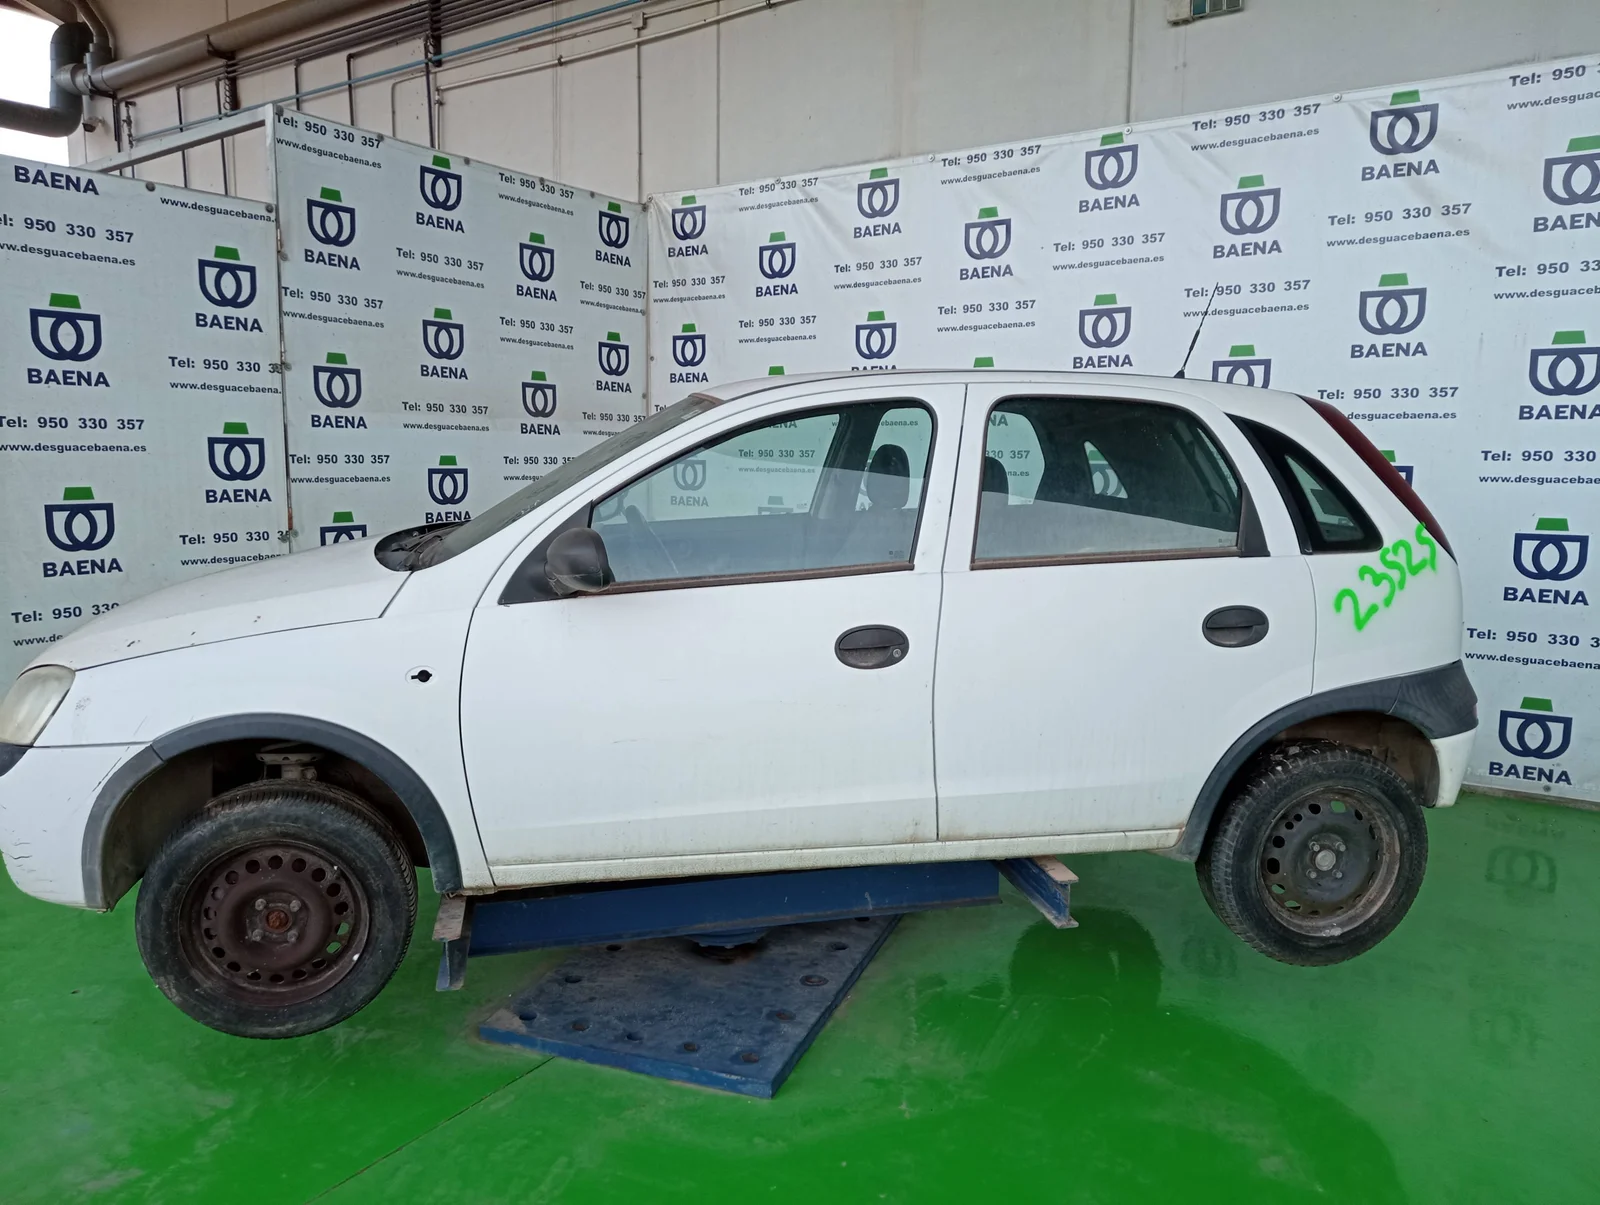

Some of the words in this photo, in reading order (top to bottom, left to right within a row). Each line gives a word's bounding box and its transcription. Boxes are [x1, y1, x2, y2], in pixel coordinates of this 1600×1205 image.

[1509, 72, 1541, 86] Tel:
[1552, 65, 1586, 80] 950
[1192, 119, 1216, 131] Tel:
[1224, 114, 1250, 126] 950
[1259, 108, 1285, 122] 330
[1294, 103, 1321, 116] 357
[275, 112, 298, 128] Tel:
[304, 121, 327, 136] 950
[334, 129, 354, 142] 330
[361, 135, 381, 149] 357
[1191, 128, 1319, 151] www.desguacebaena.es
[276, 137, 382, 169] www.desguacebaena.es
[941, 157, 960, 167] Tel:
[967, 152, 987, 164] 950
[994, 149, 1014, 160] 330
[1020, 144, 1041, 156] 357
[940, 167, 1040, 185] www.desguacebaena.es
[1362, 159, 1440, 181] BAENA
[14, 165, 99, 195] BAENA
[498, 172, 515, 184] Tel:
[520, 178, 536, 190] 950
[540, 182, 556, 195] 330
[560, 188, 574, 199] 357
[738, 186, 754, 196] Tel:
[759, 183, 776, 194] 950
[780, 180, 797, 190] 330
[802, 177, 818, 188] 357
[1079, 194, 1140, 213] BAENA
[416, 212, 465, 233] BAENA
[1328, 214, 1355, 226] Tel:
[1365, 210, 1393, 223] 950
[1402, 206, 1431, 219] 330
[1441, 203, 1472, 216] 357
[24, 218, 56, 232] 950
[66, 224, 96, 238] 330
[106, 229, 134, 243] 357
[854, 222, 902, 238] BAENA
[1326, 230, 1470, 247] www.desguacebaena.es
[1053, 242, 1075, 252] Tel:
[1082, 238, 1104, 250] 950
[1112, 235, 1134, 246] 330
[1142, 232, 1165, 244] 357
[1213, 240, 1282, 259] BAENA
[304, 248, 360, 270] BAENA
[396, 247, 415, 259] Tel:
[420, 252, 438, 264] 950
[444, 256, 462, 268] 330
[467, 260, 484, 271] 357
[596, 250, 631, 267] BAENA
[668, 244, 708, 258] BAENA
[834, 264, 851, 273] Tel:
[856, 262, 874, 271] 950
[880, 259, 898, 269] 330
[904, 256, 922, 266] 357
[1052, 256, 1164, 270] www.desguacebaena.es
[1495, 265, 1526, 277] Tel:
[1537, 262, 1569, 275] 950
[396, 270, 484, 288] www.desguacebaena.es
[960, 264, 1013, 280] BAENA
[580, 280, 594, 290] Tel:
[598, 284, 612, 294] 950
[616, 287, 629, 296] 330
[632, 289, 646, 300] 357
[653, 280, 668, 288] Tel:
[672, 278, 686, 287] 950
[691, 277, 706, 286] 330
[710, 276, 725, 284] 357
[756, 283, 798, 297] BAENA
[834, 277, 922, 290] www.desguacebaena.es
[1184, 287, 1209, 298] Tel:
[1216, 284, 1242, 296] 950
[1250, 282, 1275, 294] 330
[1284, 280, 1310, 291] 357
[281, 286, 304, 299] Tel:
[310, 290, 331, 302] 950
[338, 294, 358, 306] 330
[364, 298, 383, 309] 357
[516, 284, 557, 302] BAENA
[938, 306, 956, 315] Tel:
[963, 304, 982, 314] 950
[989, 302, 1009, 312] 330
[1015, 300, 1036, 310] 357
[196, 312, 263, 332] BAENA
[282, 310, 385, 328] www.desguacebaena.es
[500, 316, 516, 326] Tel:
[520, 319, 535, 329] 950
[540, 322, 555, 332] 330
[558, 324, 573, 334] 357
[738, 320, 754, 328] Tel:
[758, 318, 774, 327] 950
[779, 316, 795, 326] 330
[800, 315, 816, 324] 357
[937, 321, 1035, 332] www.desguacebaena.es
[1350, 342, 1428, 358] BAENA
[168, 356, 195, 368] Tel:
[203, 359, 228, 370] 950
[236, 361, 260, 372] 330
[1073, 354, 1133, 369] BAENA
[27, 368, 110, 387] BAENA
[420, 364, 468, 380] BAENA
[670, 372, 708, 383] BAENA
[596, 380, 632, 393] BAENA
[1318, 389, 1344, 400] Tel:
[1354, 388, 1381, 399] 950
[1391, 388, 1419, 398] 330
[1429, 387, 1458, 398] 357
[402, 402, 420, 411] Tel:
[426, 403, 444, 412] 950
[450, 404, 467, 414] 330
[472, 406, 488, 414] 357
[38, 416, 68, 428] 950
[78, 418, 107, 429] 330
[117, 419, 144, 430] 357
[311, 414, 367, 429] BAENA
[403, 422, 490, 431] www.desguacebaena.es
[520, 423, 560, 435] BAENA
[0, 443, 146, 454] www.desguacebaena.es
[738, 449, 754, 457] Tel:
[758, 449, 774, 458] 950
[778, 450, 794, 458] 330
[799, 450, 815, 458] 357
[1009, 450, 1030, 459] 357
[1481, 450, 1511, 461] Tel:
[1522, 450, 1553, 461] 950
[1564, 450, 1596, 462] 330
[289, 454, 311, 464] Tel:
[317, 454, 338, 464] 950
[344, 454, 364, 464] 330
[371, 454, 390, 464] 357
[503, 456, 519, 464] Tel:
[524, 456, 539, 464] 950
[543, 456, 558, 464] 330
[290, 475, 391, 484] www.desguacebaena.es
[206, 488, 272, 503] BAENA
[670, 496, 709, 507] BAENA
[425, 510, 472, 524] BAENA
[179, 534, 205, 545] Tel:
[213, 532, 238, 543] 950
[246, 531, 269, 542] 330
[43, 558, 123, 578] BAENA
[1503, 587, 1589, 606] BAENA
[11, 610, 42, 623] Tel:
[52, 606, 82, 619] 950
[1467, 628, 1496, 640] Tel:
[1506, 631, 1537, 643] 950
[1548, 634, 1579, 646] 330
[1489, 762, 1572, 785] BAENA
